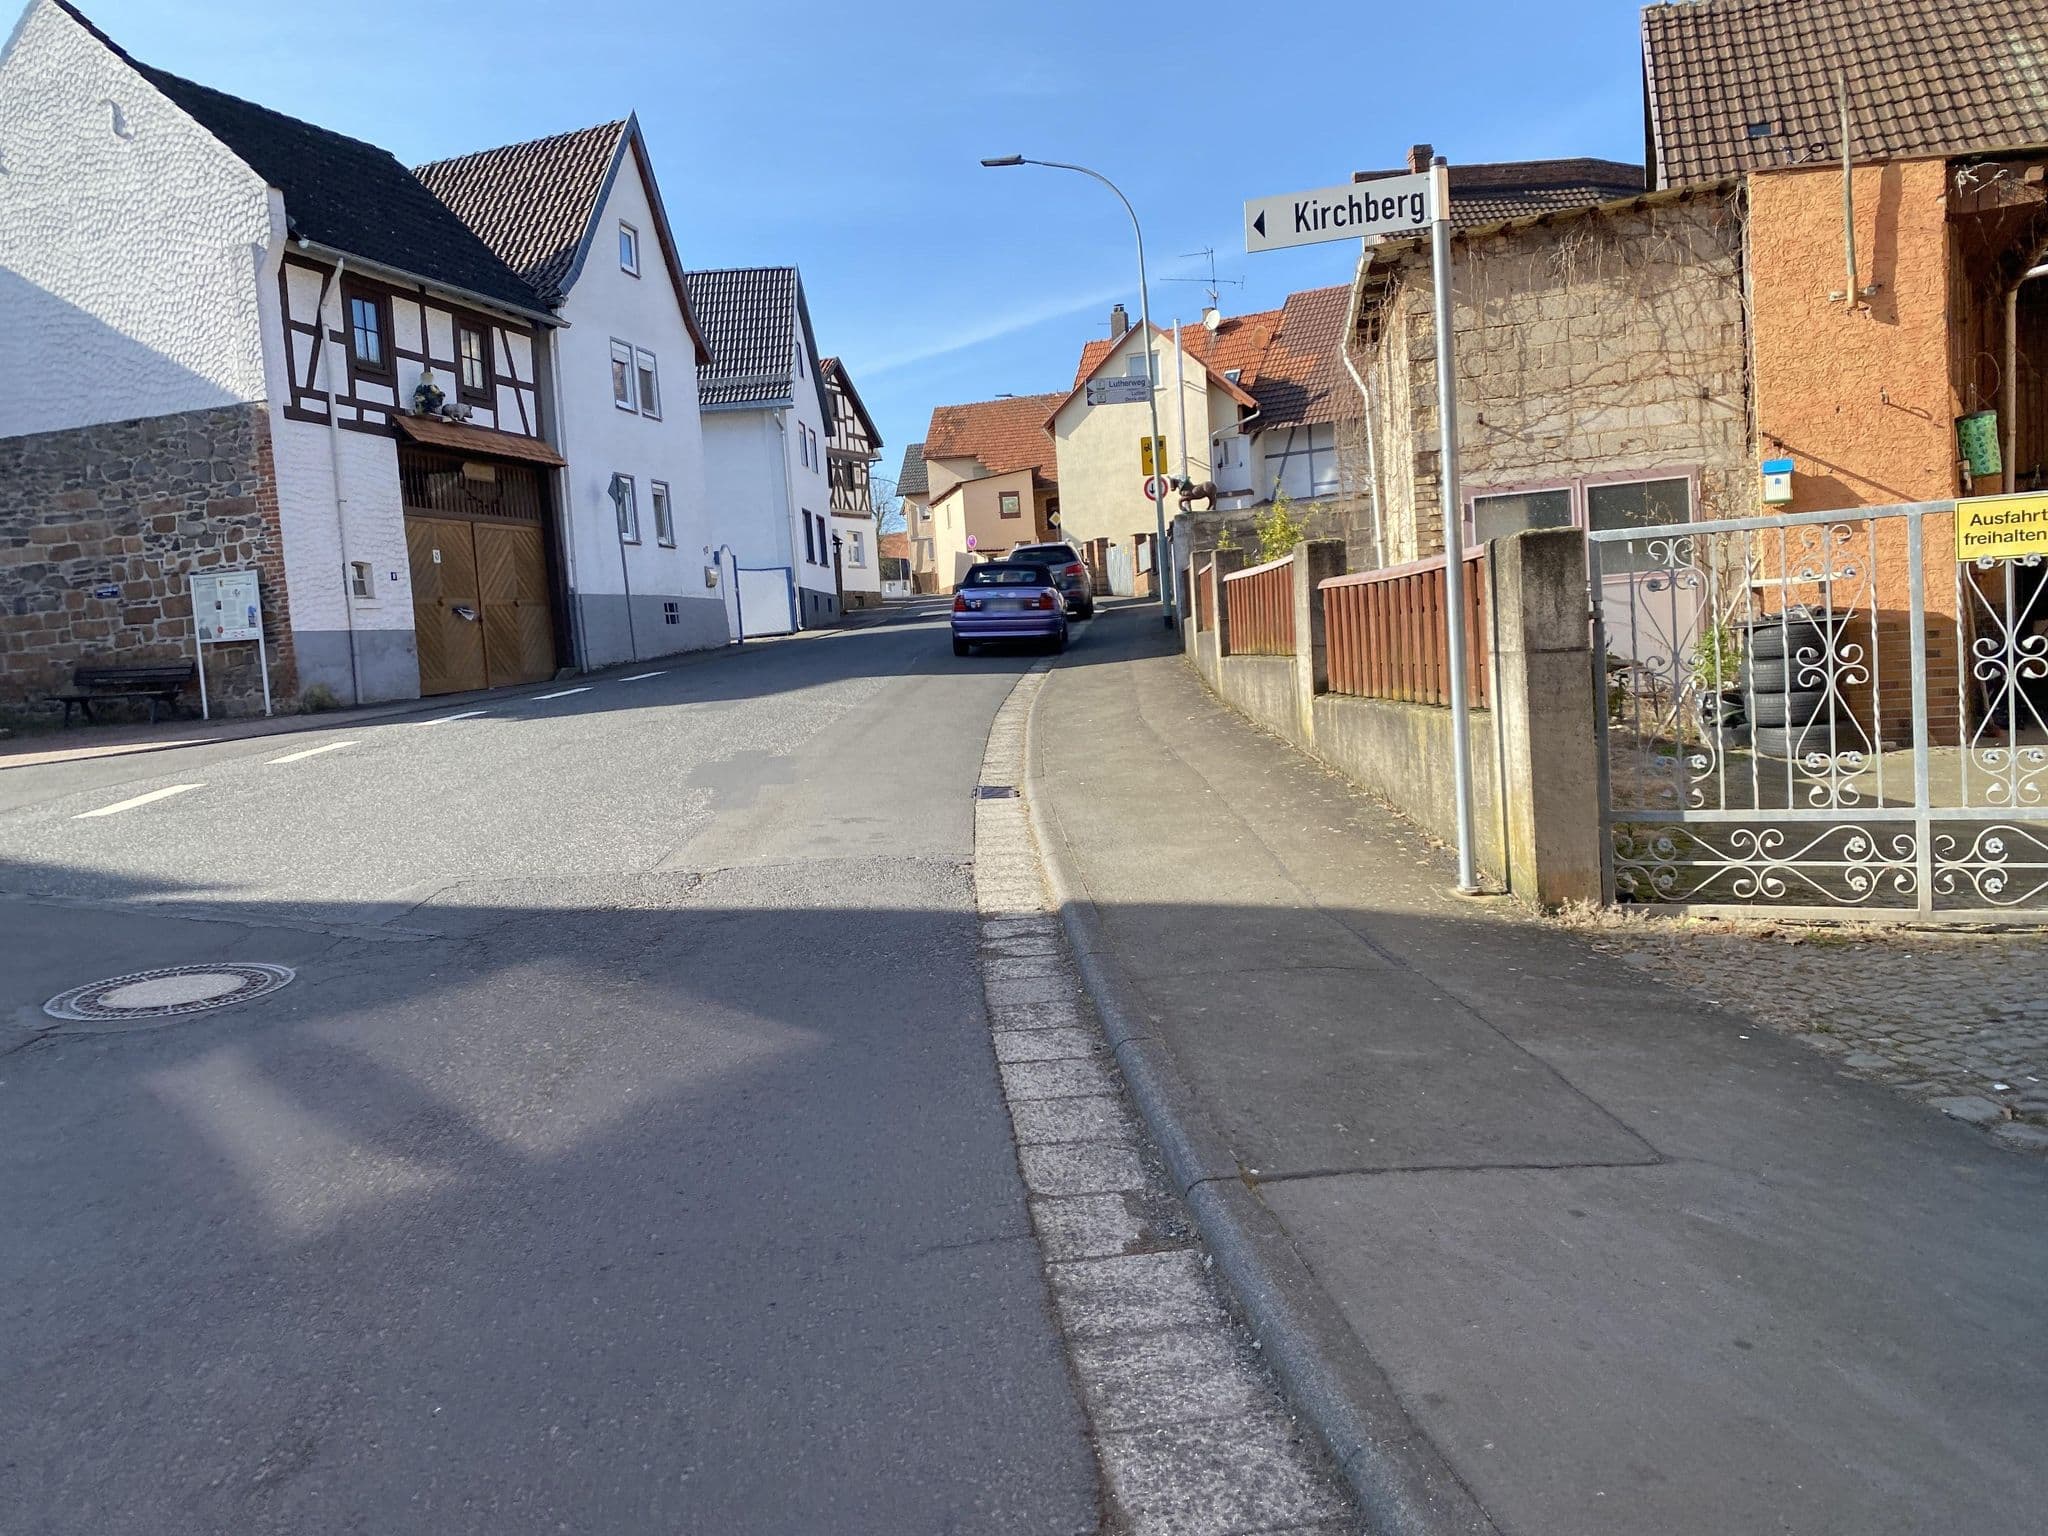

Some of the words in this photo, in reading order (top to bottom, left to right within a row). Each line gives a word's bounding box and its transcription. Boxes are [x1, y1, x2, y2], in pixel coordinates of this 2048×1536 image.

[1294, 192, 1425, 233] Kirchberg
[1108, 379, 1146, 388] Lutherweg
[1970, 508, 2048, 526] Ausfahrt
[1964, 528, 2048, 546] freihalten
